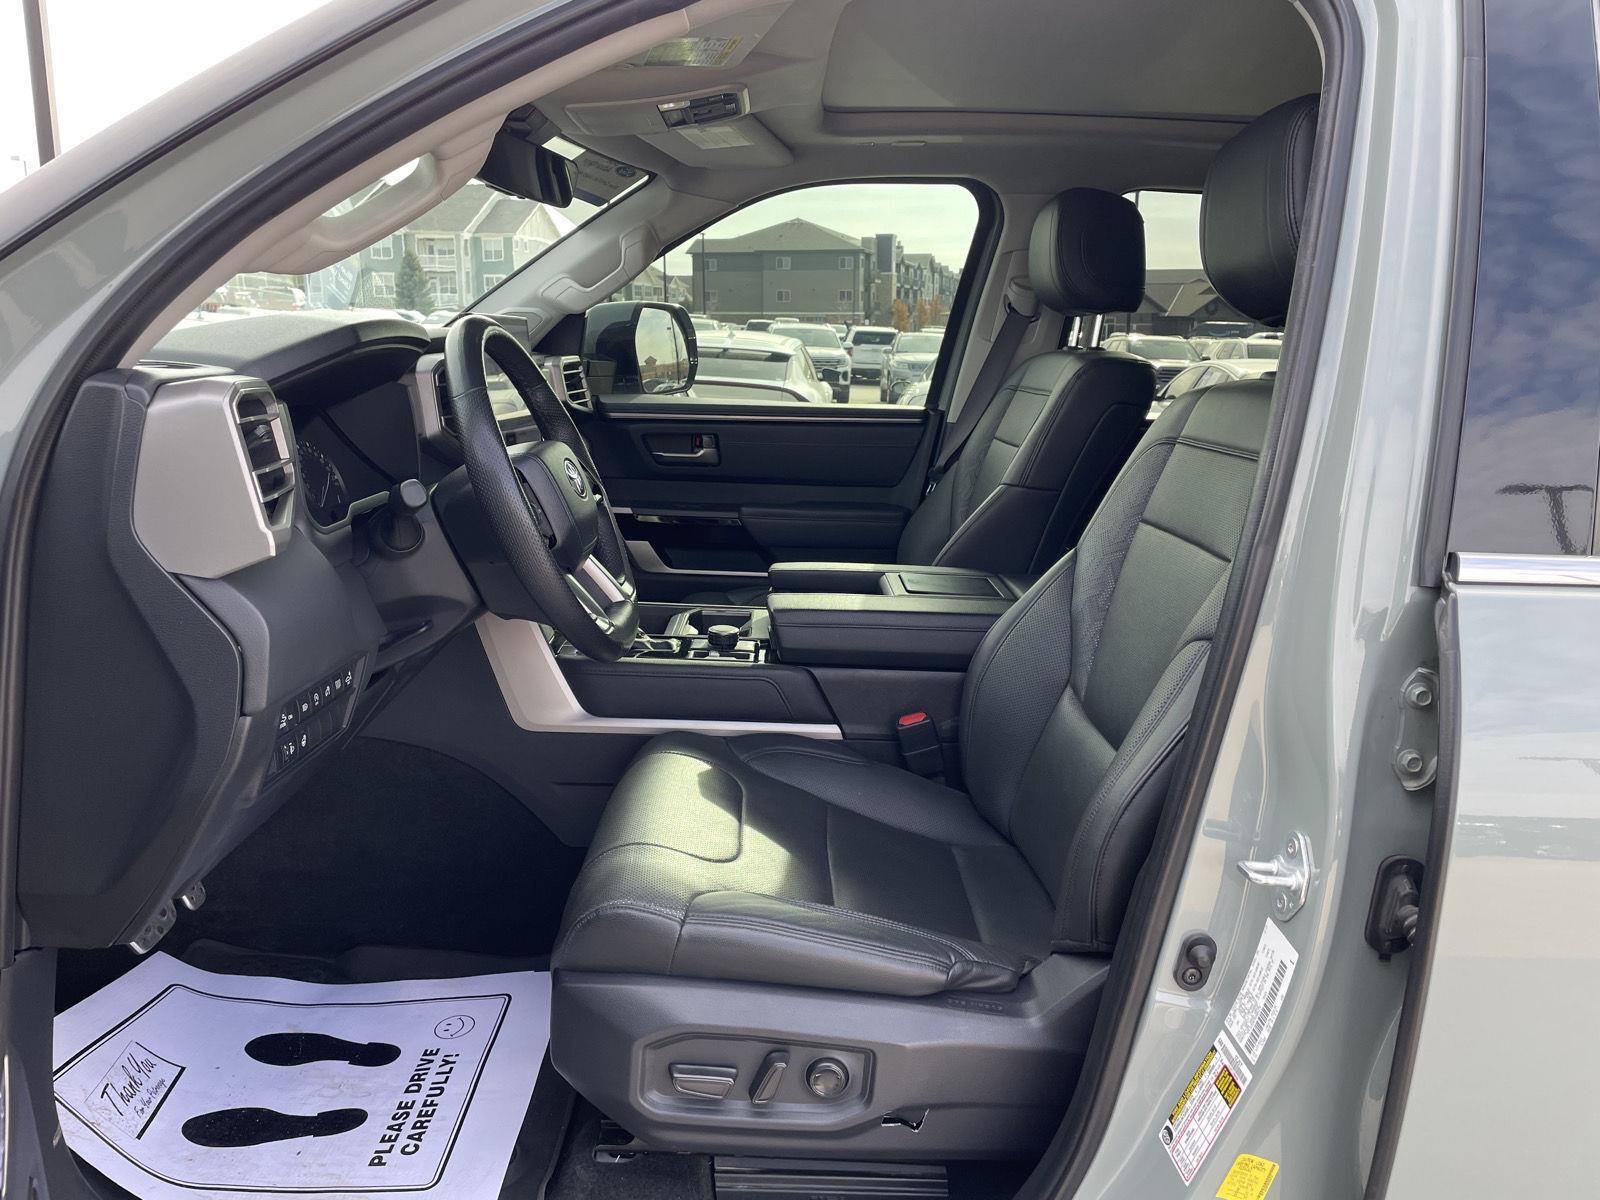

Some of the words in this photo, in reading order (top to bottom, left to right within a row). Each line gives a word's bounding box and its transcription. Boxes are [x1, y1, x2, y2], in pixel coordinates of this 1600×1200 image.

[100, 1064, 143, 1117] Thank
[127, 1053, 157, 1079] You
[134, 1105, 145, 1119] For
[368, 1099, 416, 1167] PLEASE
[403, 1047, 441, 1094] DRIVE
[400, 1053, 460, 1156] CAREFULLY!
